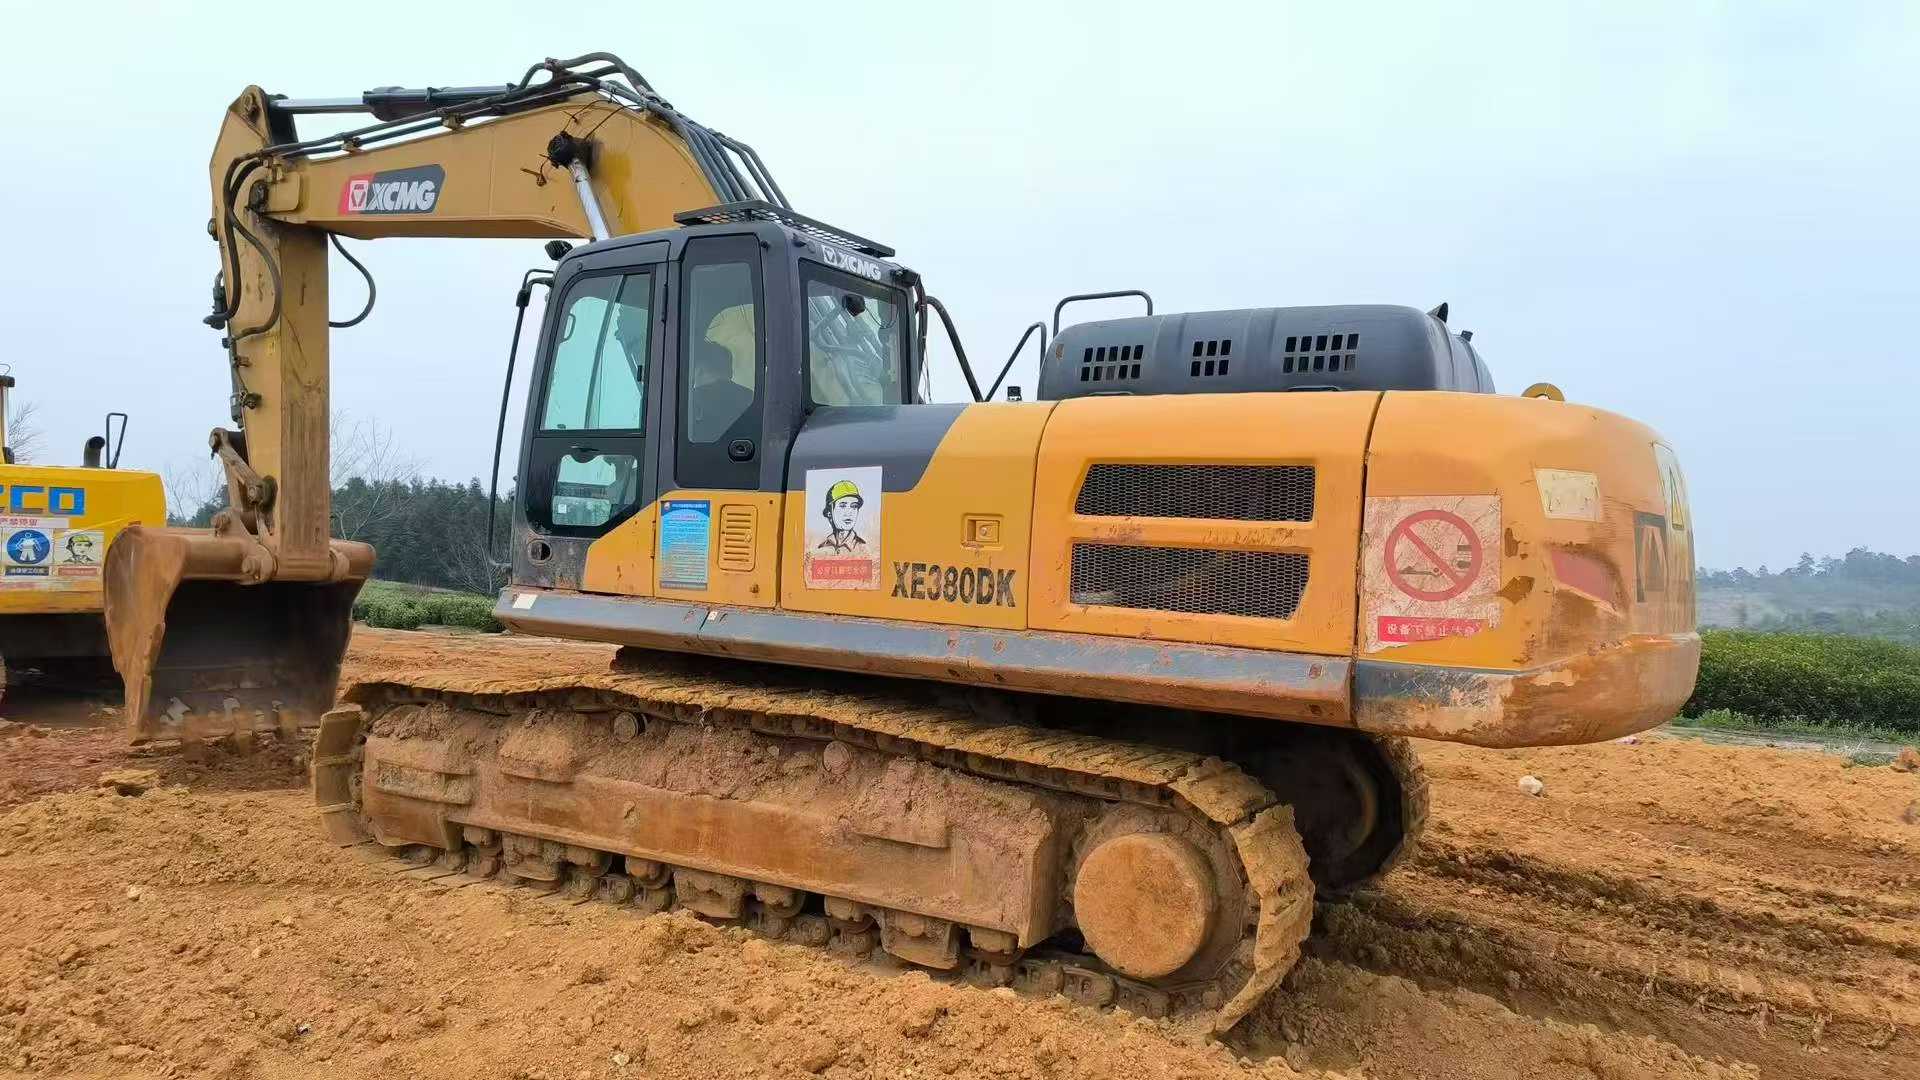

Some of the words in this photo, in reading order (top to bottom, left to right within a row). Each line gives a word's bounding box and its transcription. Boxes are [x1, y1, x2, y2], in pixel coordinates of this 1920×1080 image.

[366, 180, 436, 212] XCMG
[838, 252, 882, 281] XCMG
[0, 485, 84, 515] CO
[891, 561, 1017, 608] XE380DK
